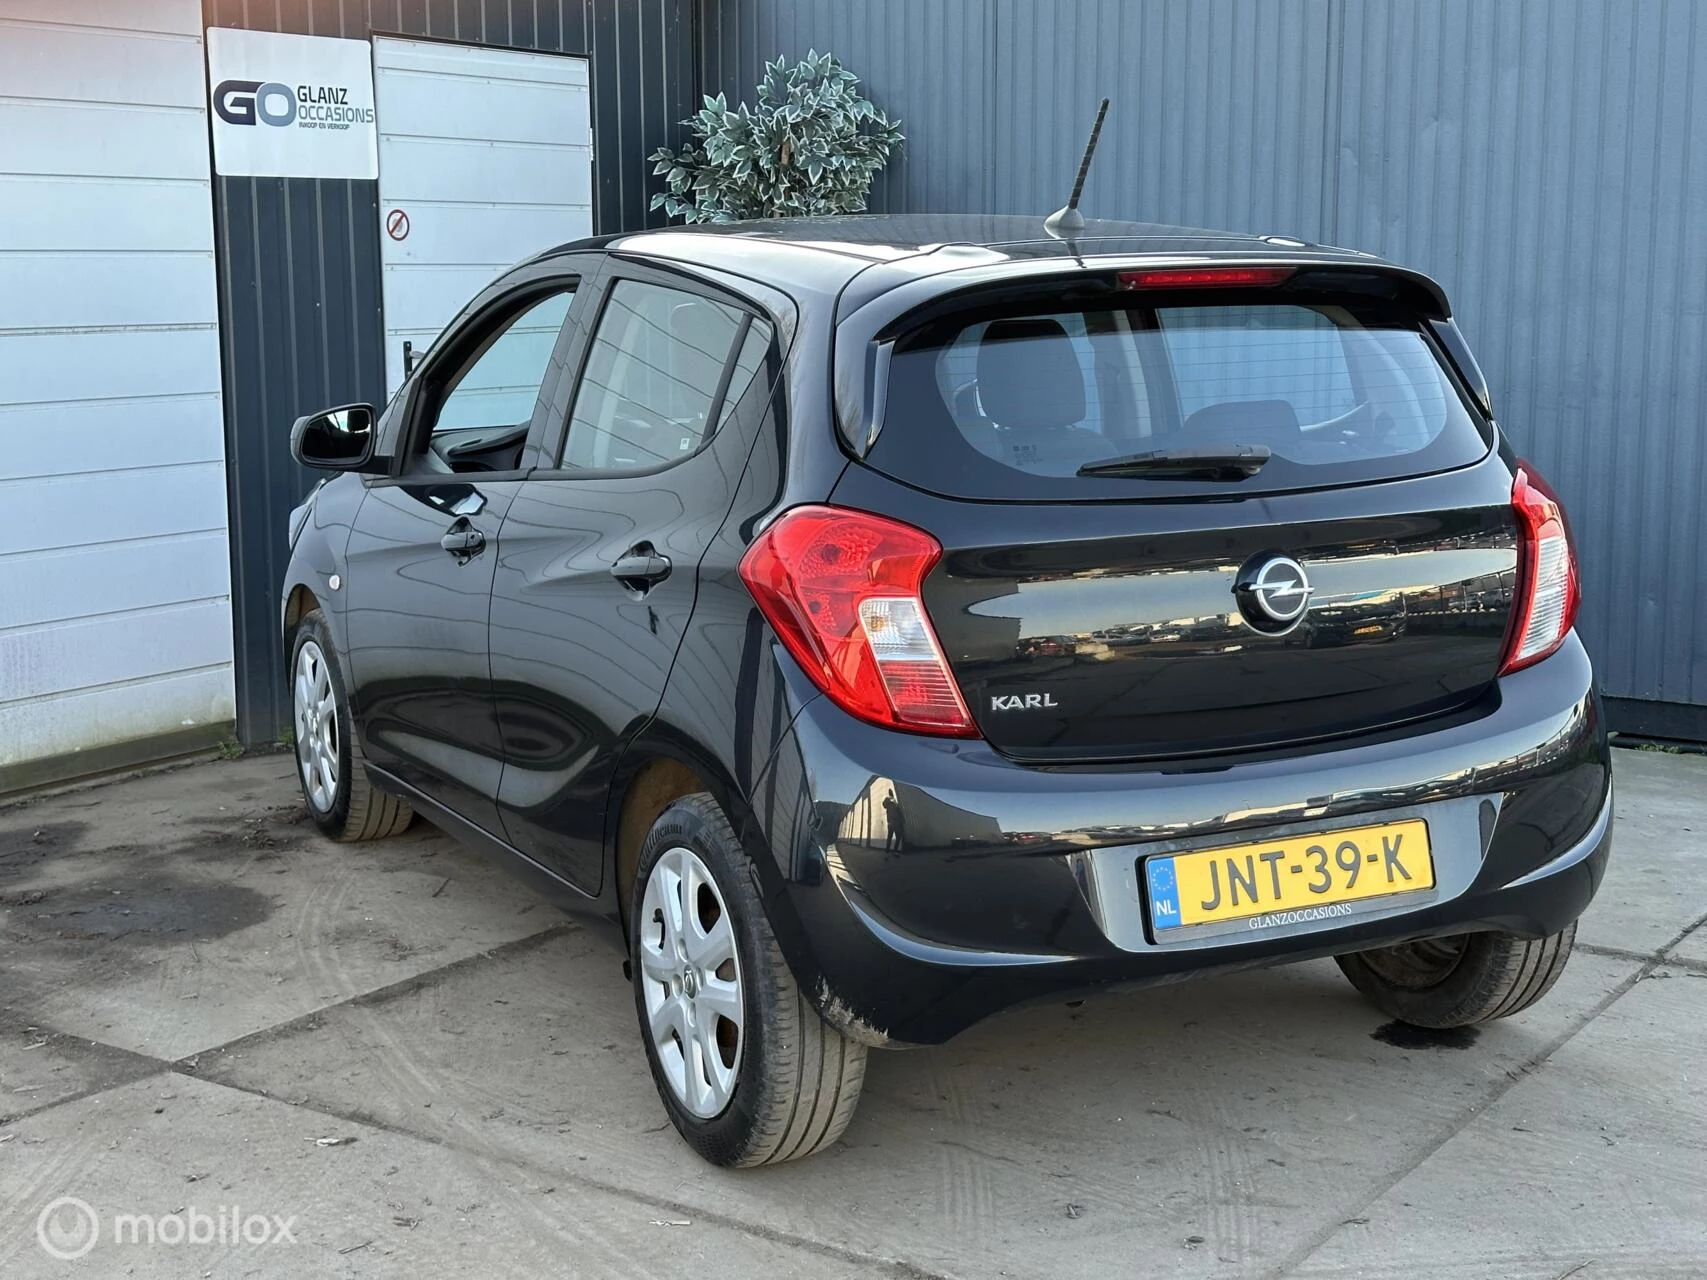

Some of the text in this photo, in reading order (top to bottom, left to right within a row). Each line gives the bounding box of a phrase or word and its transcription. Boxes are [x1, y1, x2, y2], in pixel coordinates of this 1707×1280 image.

[213, 80, 297, 127] GO
[297, 85, 348, 105] GLANZ
[298, 104, 374, 123] OCCASIONS
[991, 693, 1059, 711] KARL
[1201, 834, 1412, 910] JNT-39-K
[1155, 899, 1177, 916] NL
[1248, 903, 1352, 930] GLANZOCCASIONS
